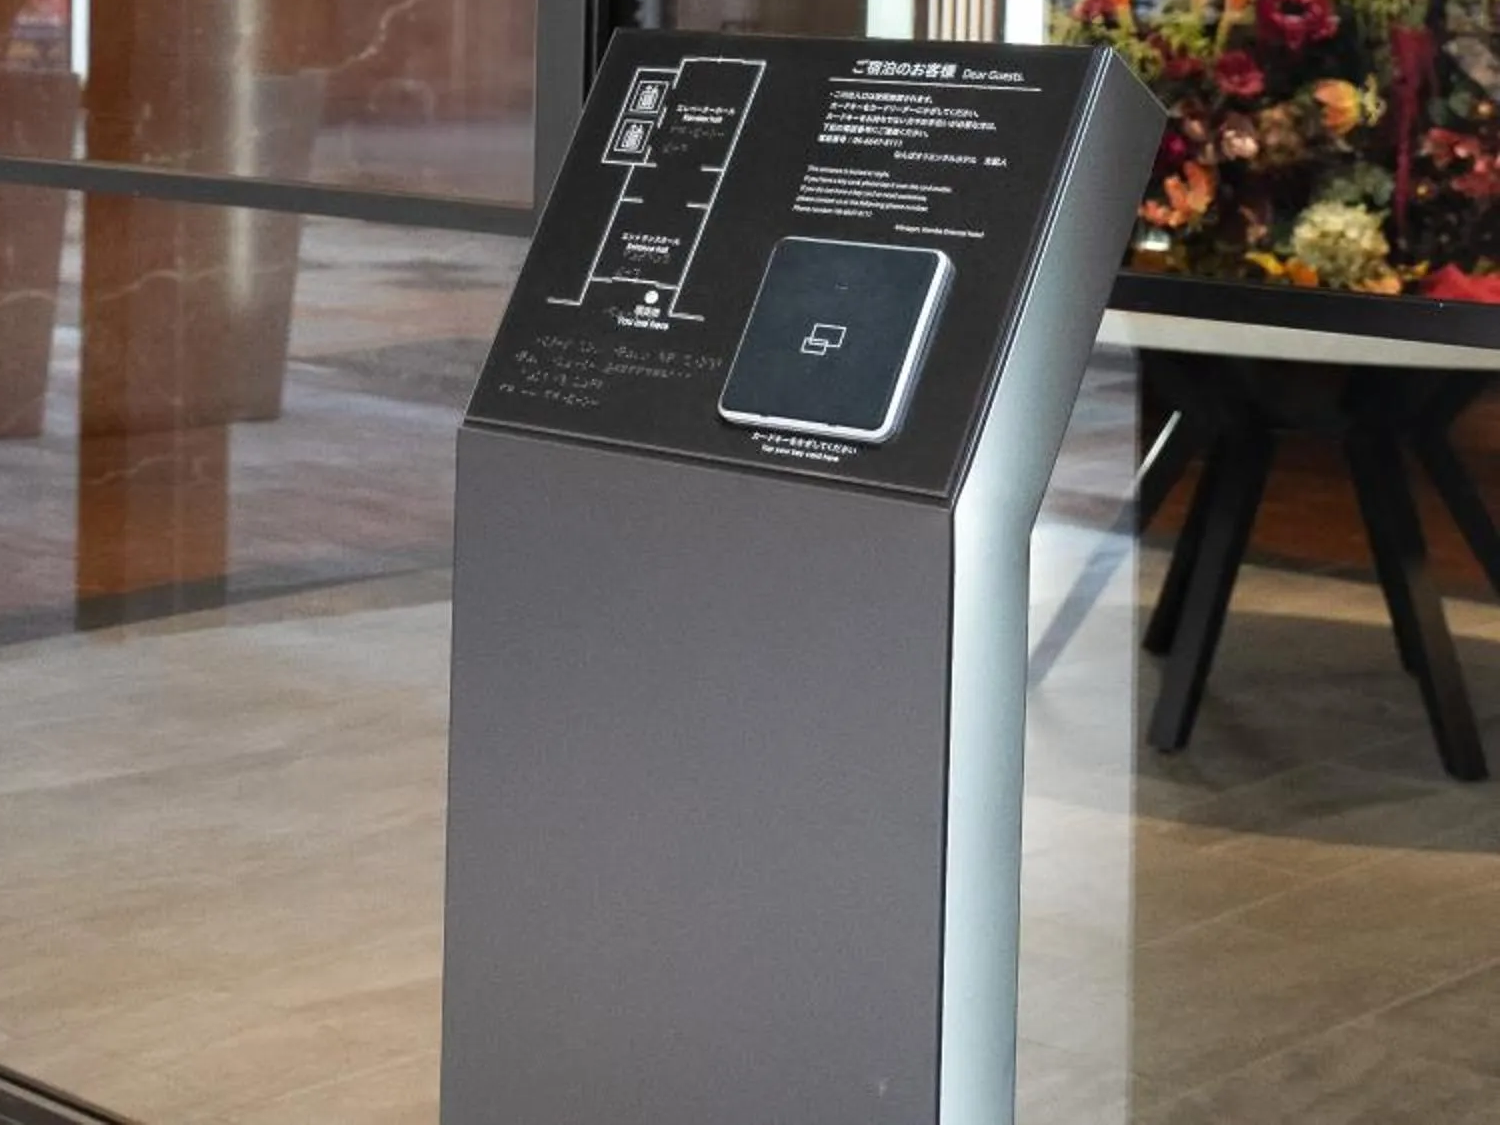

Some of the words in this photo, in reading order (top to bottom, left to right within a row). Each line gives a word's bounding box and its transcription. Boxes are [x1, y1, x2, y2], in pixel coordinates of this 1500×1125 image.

[852, 59, 957, 79] ご宿泊のお客様
[961, 68, 988, 81] Dear
